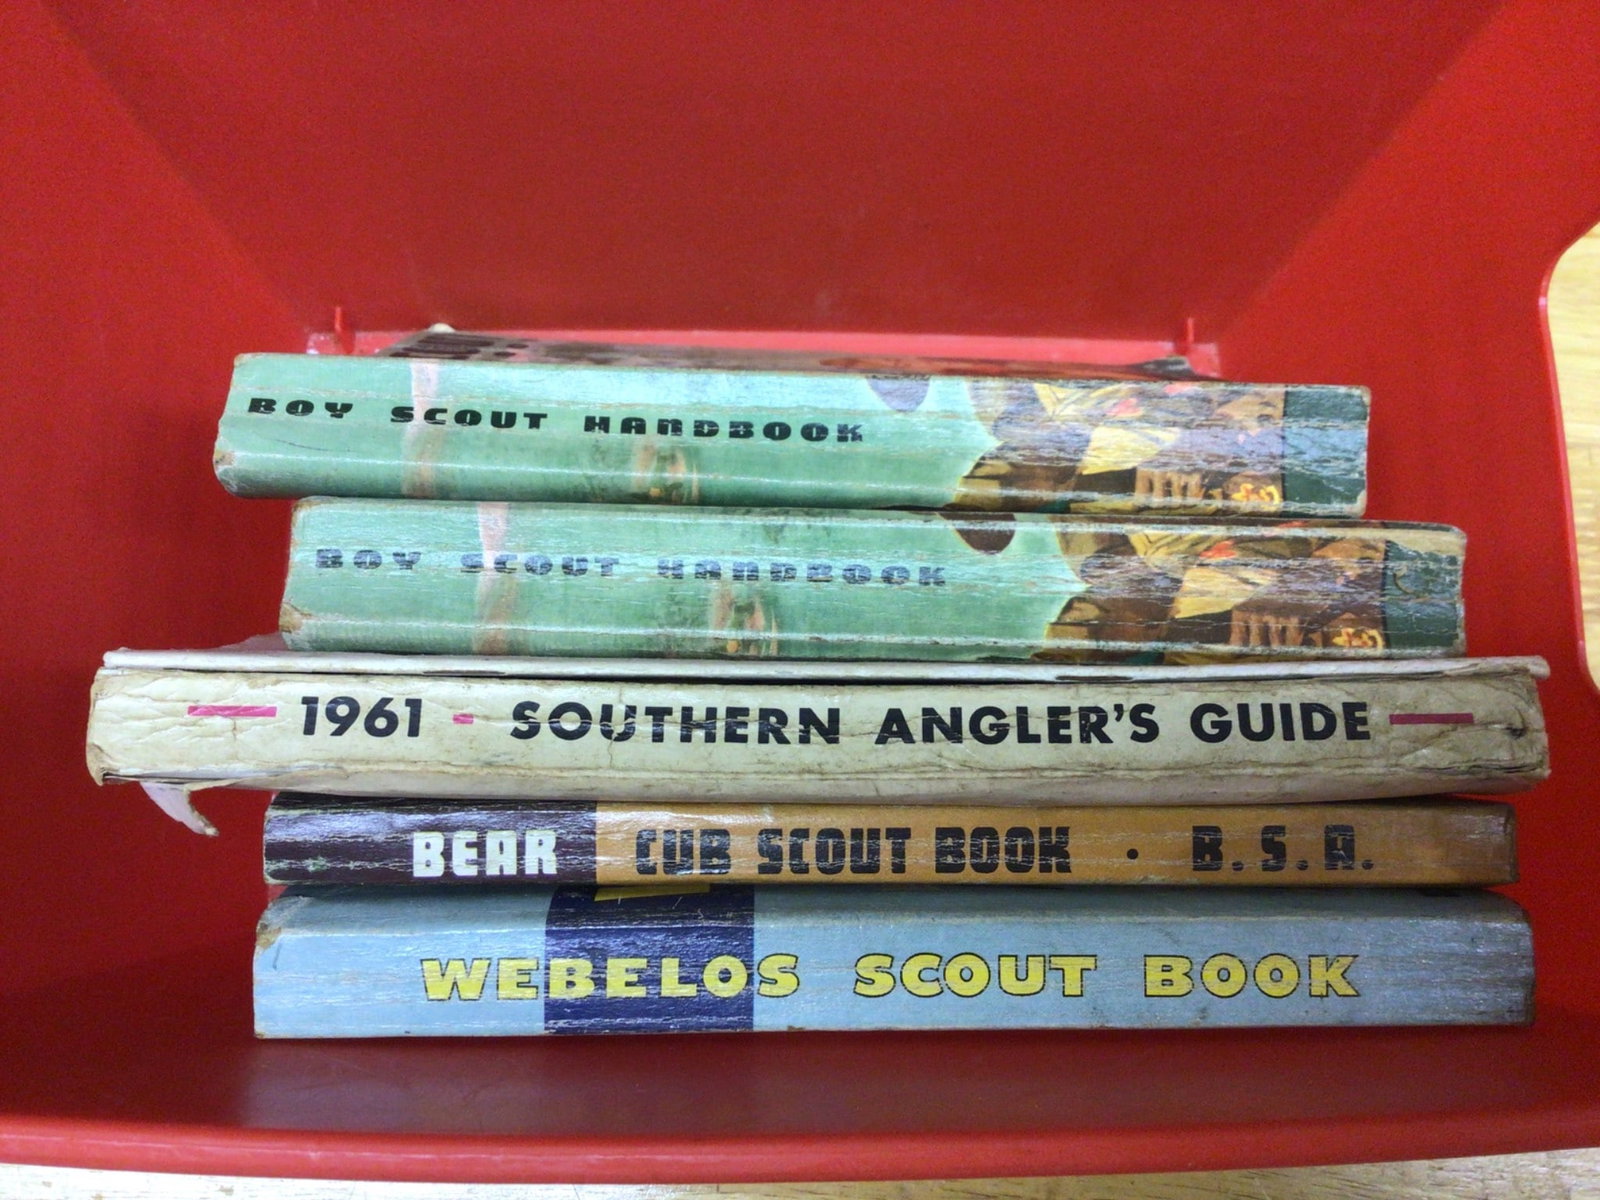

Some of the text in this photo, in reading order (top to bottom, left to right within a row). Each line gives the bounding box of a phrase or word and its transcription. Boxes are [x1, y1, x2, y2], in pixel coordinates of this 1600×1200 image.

[248, 397, 865, 443] BOY SCOUT HANDBOOK
[315, 547, 947, 587] BOY SCOUT HANDBOOK
[301, 695, 1372, 746] 1961 SOUTHERN ANGLER'S GUIDE
[412, 828, 558, 879] BEAR
[636, 827, 730, 876] CUB
[757, 827, 911, 874] SCOUT
[935, 827, 1072, 874] BOOK
[420, 953, 1361, 1003] WEBELOS SCOUT BOOK
